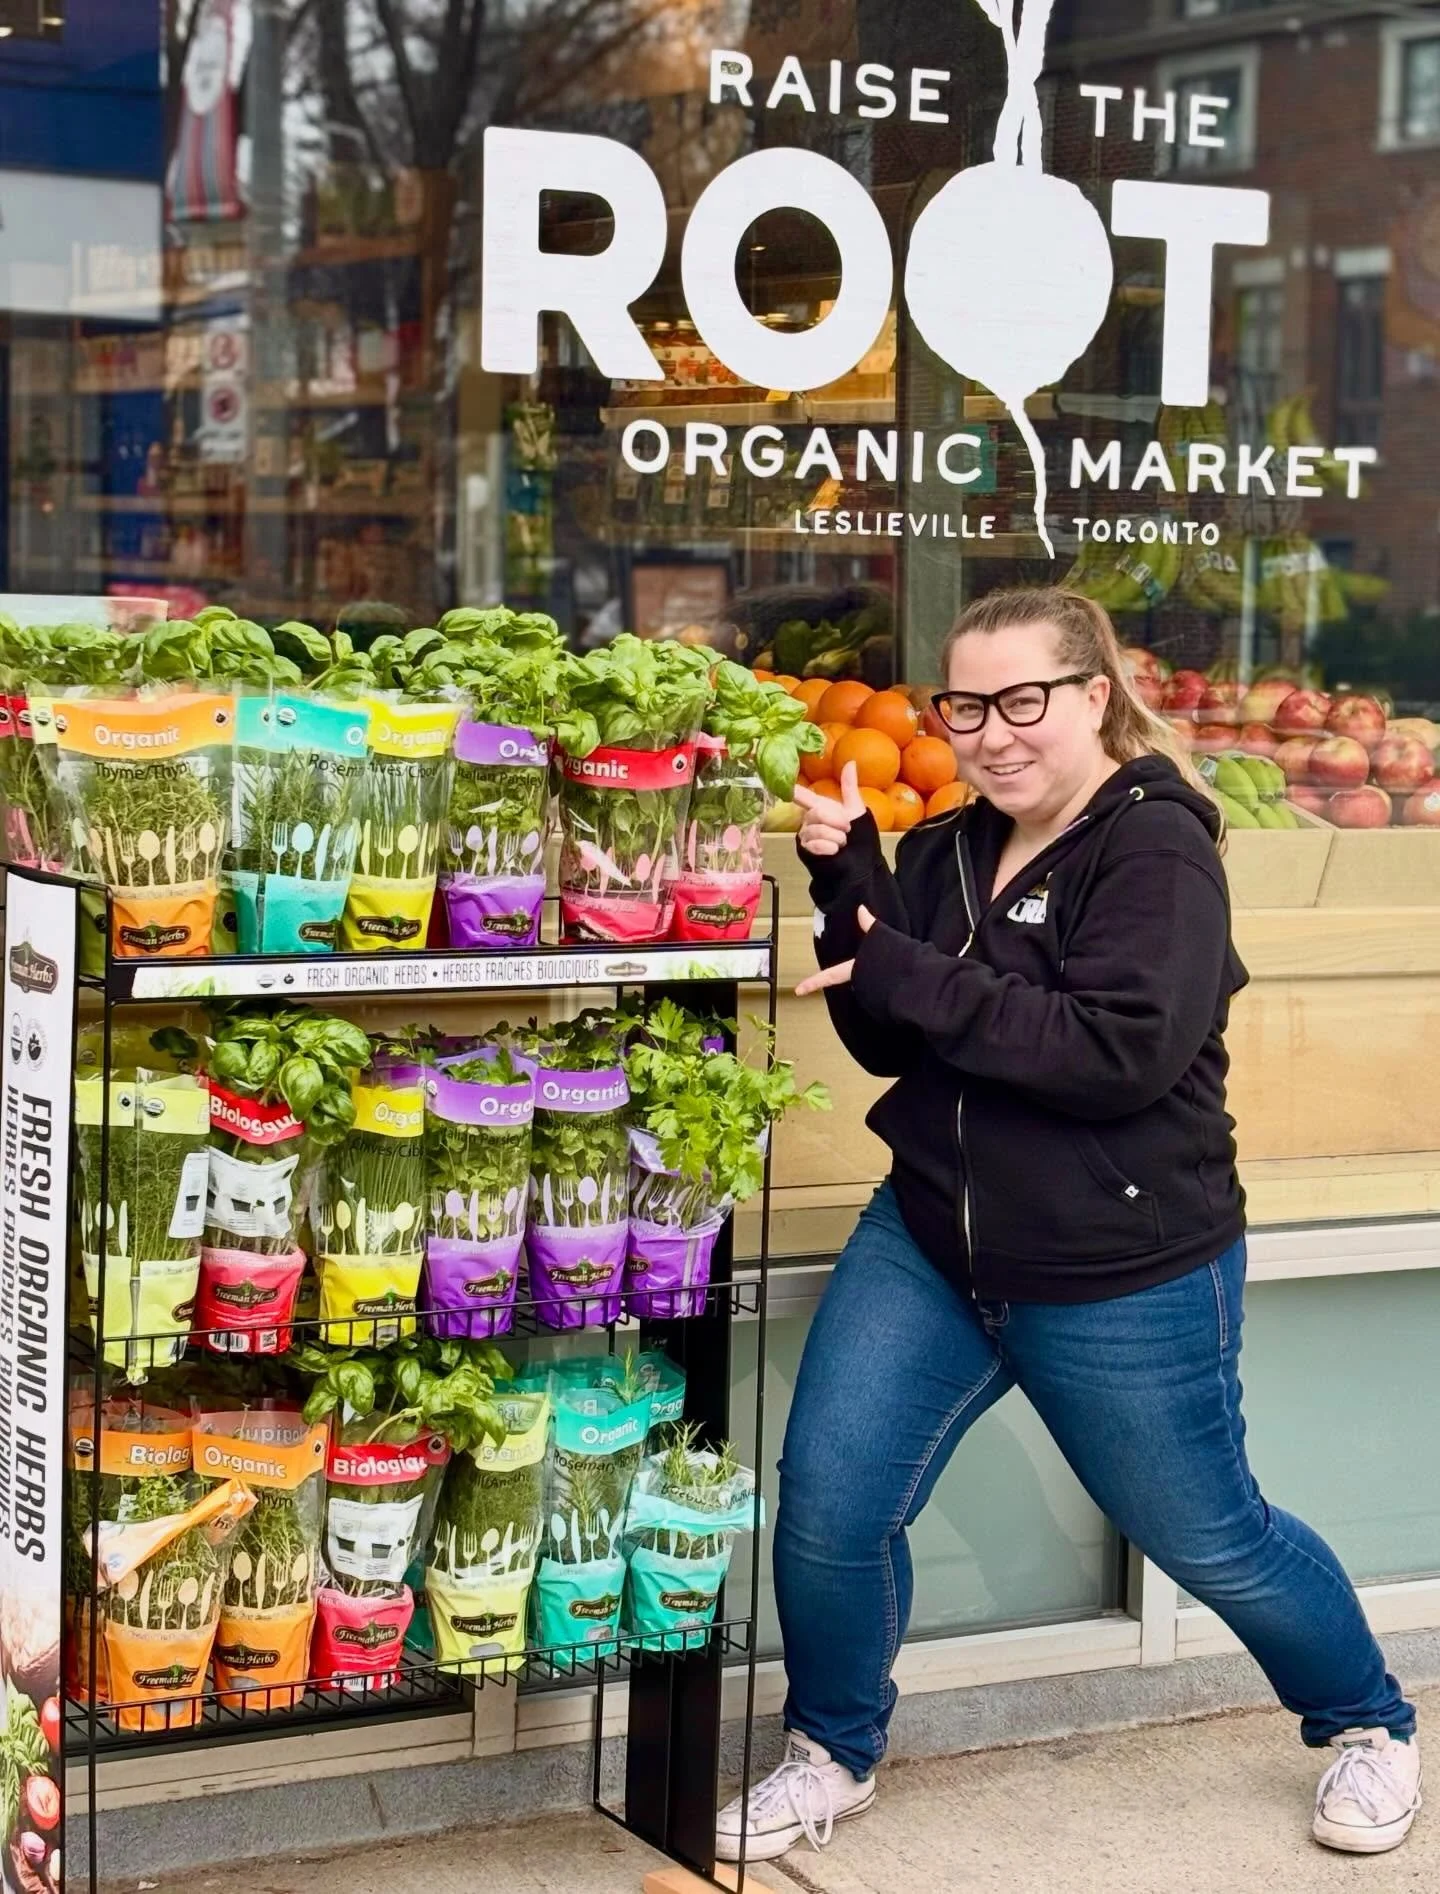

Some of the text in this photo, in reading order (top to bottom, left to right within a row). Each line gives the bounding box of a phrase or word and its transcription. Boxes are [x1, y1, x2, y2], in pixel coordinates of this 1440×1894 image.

[709, 49, 1230, 148] RAISE THE
[621, 419, 1377, 499] ORGANIC MARKET
[794, 509, 1221, 546] LESLIEVILLE TORONTO
[94, 724, 181, 750] Organic
[307, 966, 340, 988] FRESH
[344, 965, 389, 987] ORGANIC
[394, 963, 427, 985] HERBS
[443, 962, 482, 983] HERBES
[14, 1093, 52, 1563] FRESH ORGANIC HERBS
[205, 1446, 287, 1478] Organic
[246, 1653, 274, 1665] Herbs
